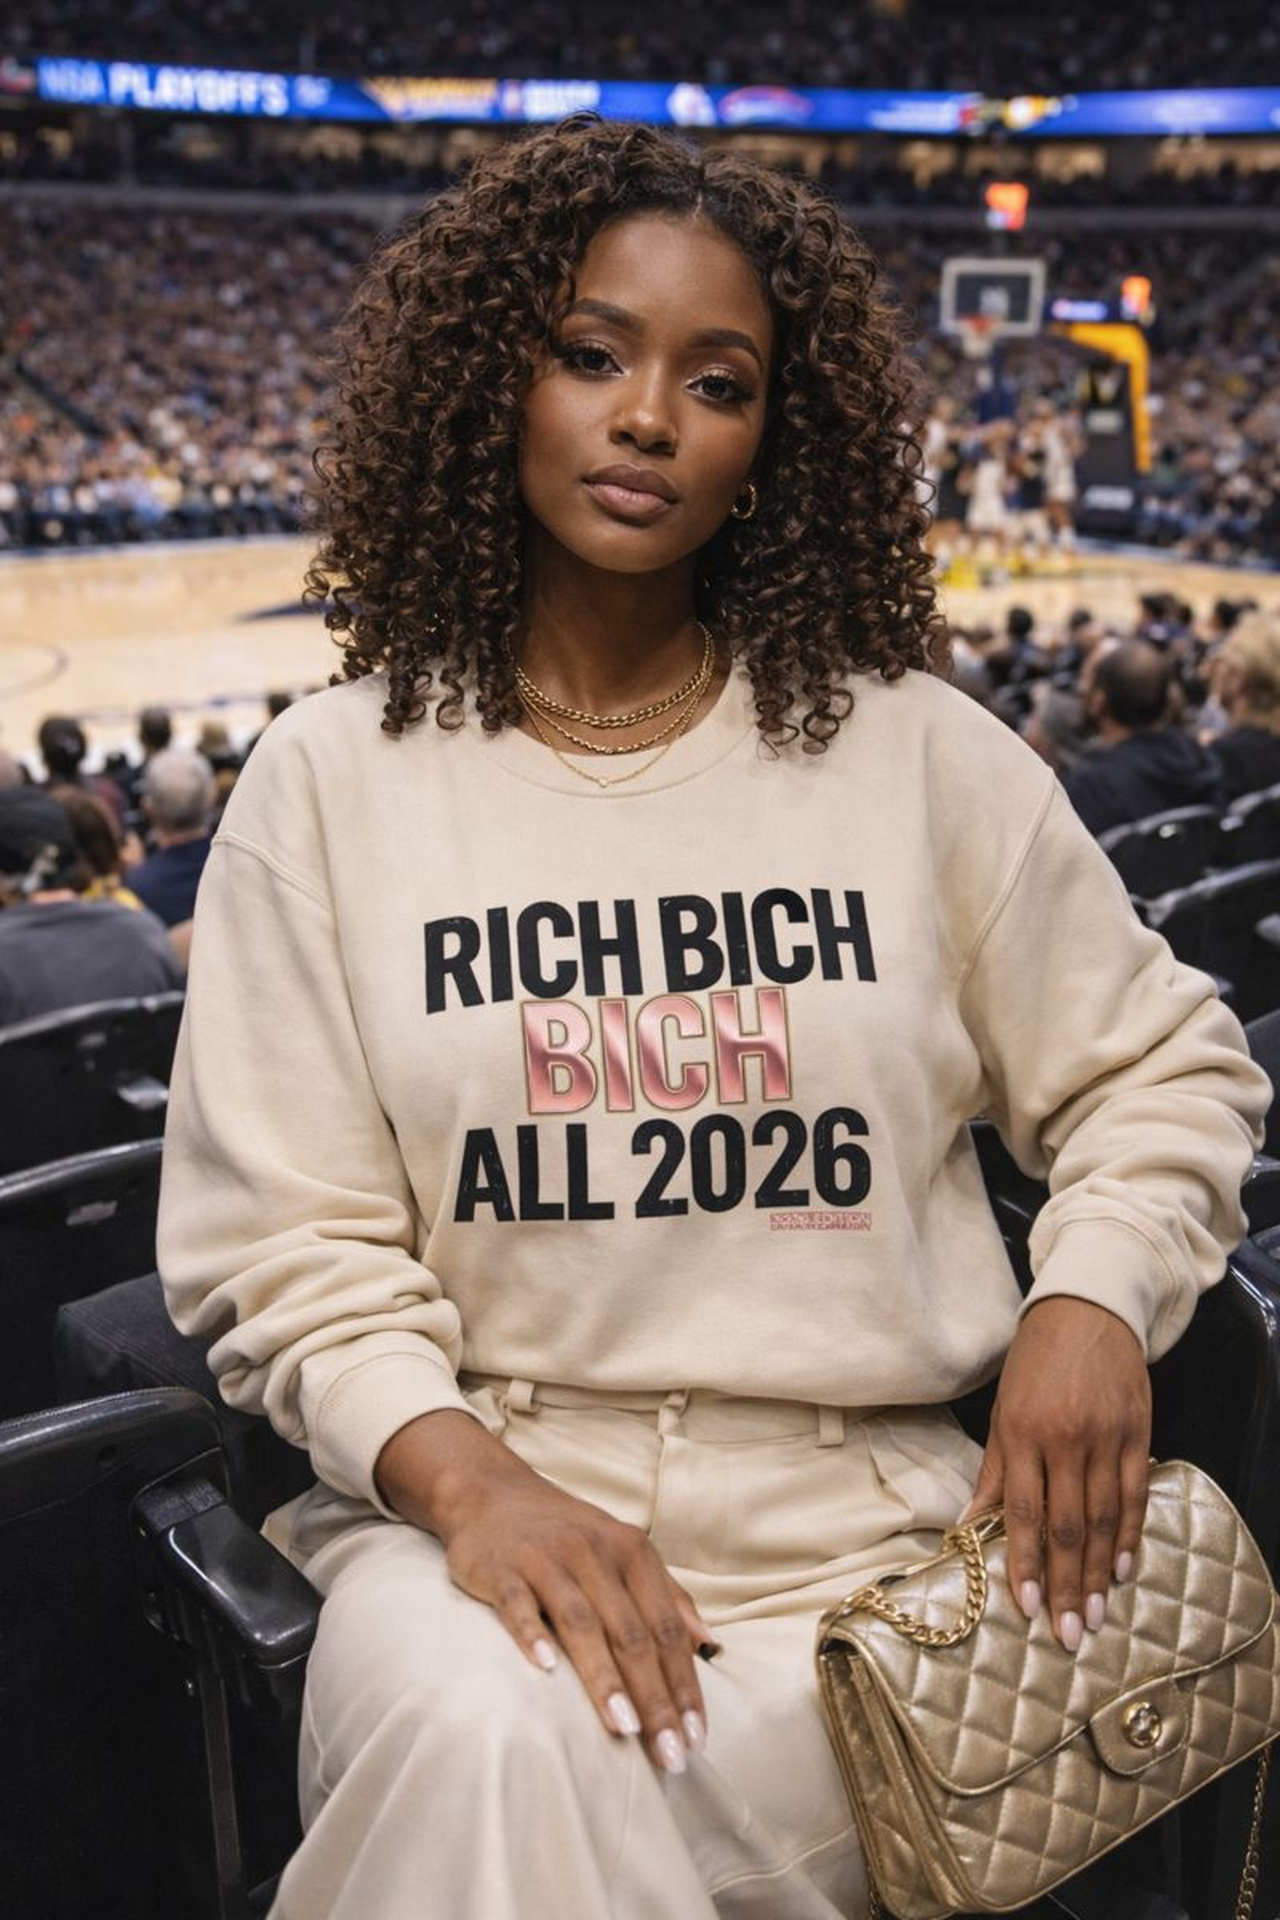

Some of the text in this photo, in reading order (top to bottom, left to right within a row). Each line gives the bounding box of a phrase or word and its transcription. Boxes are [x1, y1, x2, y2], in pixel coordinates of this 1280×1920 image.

[109, 62, 289, 116] PLAYOFFS
[424, 888, 877, 1014] RICH BICH
[520, 986, 793, 1116] BICH
[454, 1107, 872, 1222] ALL 2026
